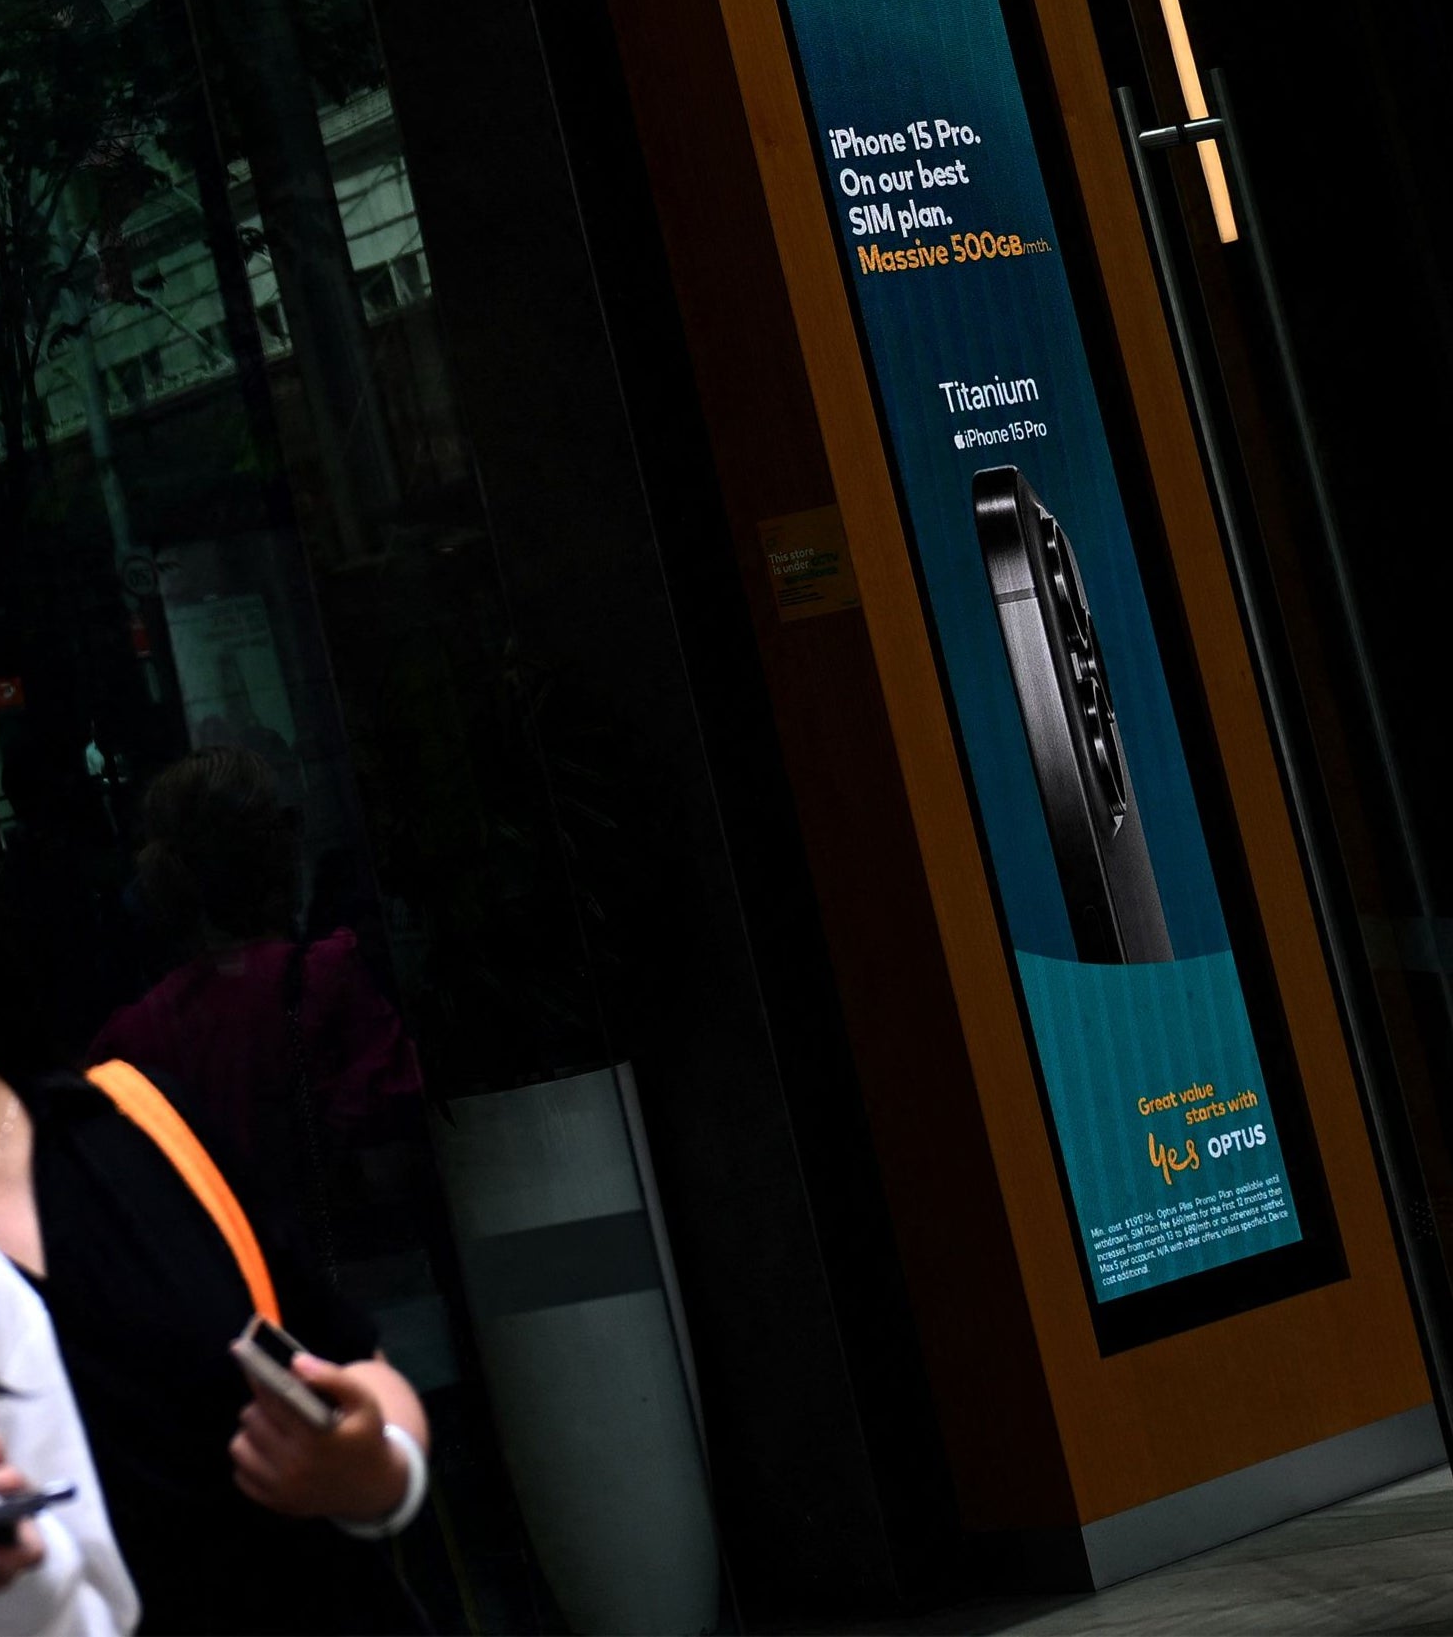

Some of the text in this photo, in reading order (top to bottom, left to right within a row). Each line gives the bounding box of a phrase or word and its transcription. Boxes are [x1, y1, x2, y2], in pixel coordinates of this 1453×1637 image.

[829, 119, 981, 159] iPhone 15 Pro.
[840, 159, 970, 196] On our best
[849, 199, 953, 238] SIM plan.
[857, 238, 949, 275] Massive
[938, 375, 1039, 413] Titanium
[964, 420, 1047, 448] iPhone 15 Pro
[1137, 1082, 1214, 1115] Great value
[1185, 1090, 1258, 1125] starts with
[1207, 1124, 1267, 1158] OPTUS
[1107, 1221, 1122, 1234] cost
[1156, 1205, 1177, 1219] Optus
[1194, 1192, 1216, 1207] Promo
[1218, 1187, 1233, 1200] Plan
[1130, 1228, 1144, 1239] SIM
[1144, 1223, 1159, 1235] Plan
[1199, 1208, 1208, 1218] for
[1209, 1204, 1221, 1215] the
[1236, 1197, 1243, 1207] 12
[1126, 1240, 1143, 1253] from
[1143, 1234, 1165, 1248] month
[1166, 1231, 1173, 1241] 13
[1174, 1228, 1182, 1238] to
[1211, 1217, 1219, 1227] or
[1119, 1257, 1130, 1268] per
[1156, 1245, 1170, 1257] N/A
